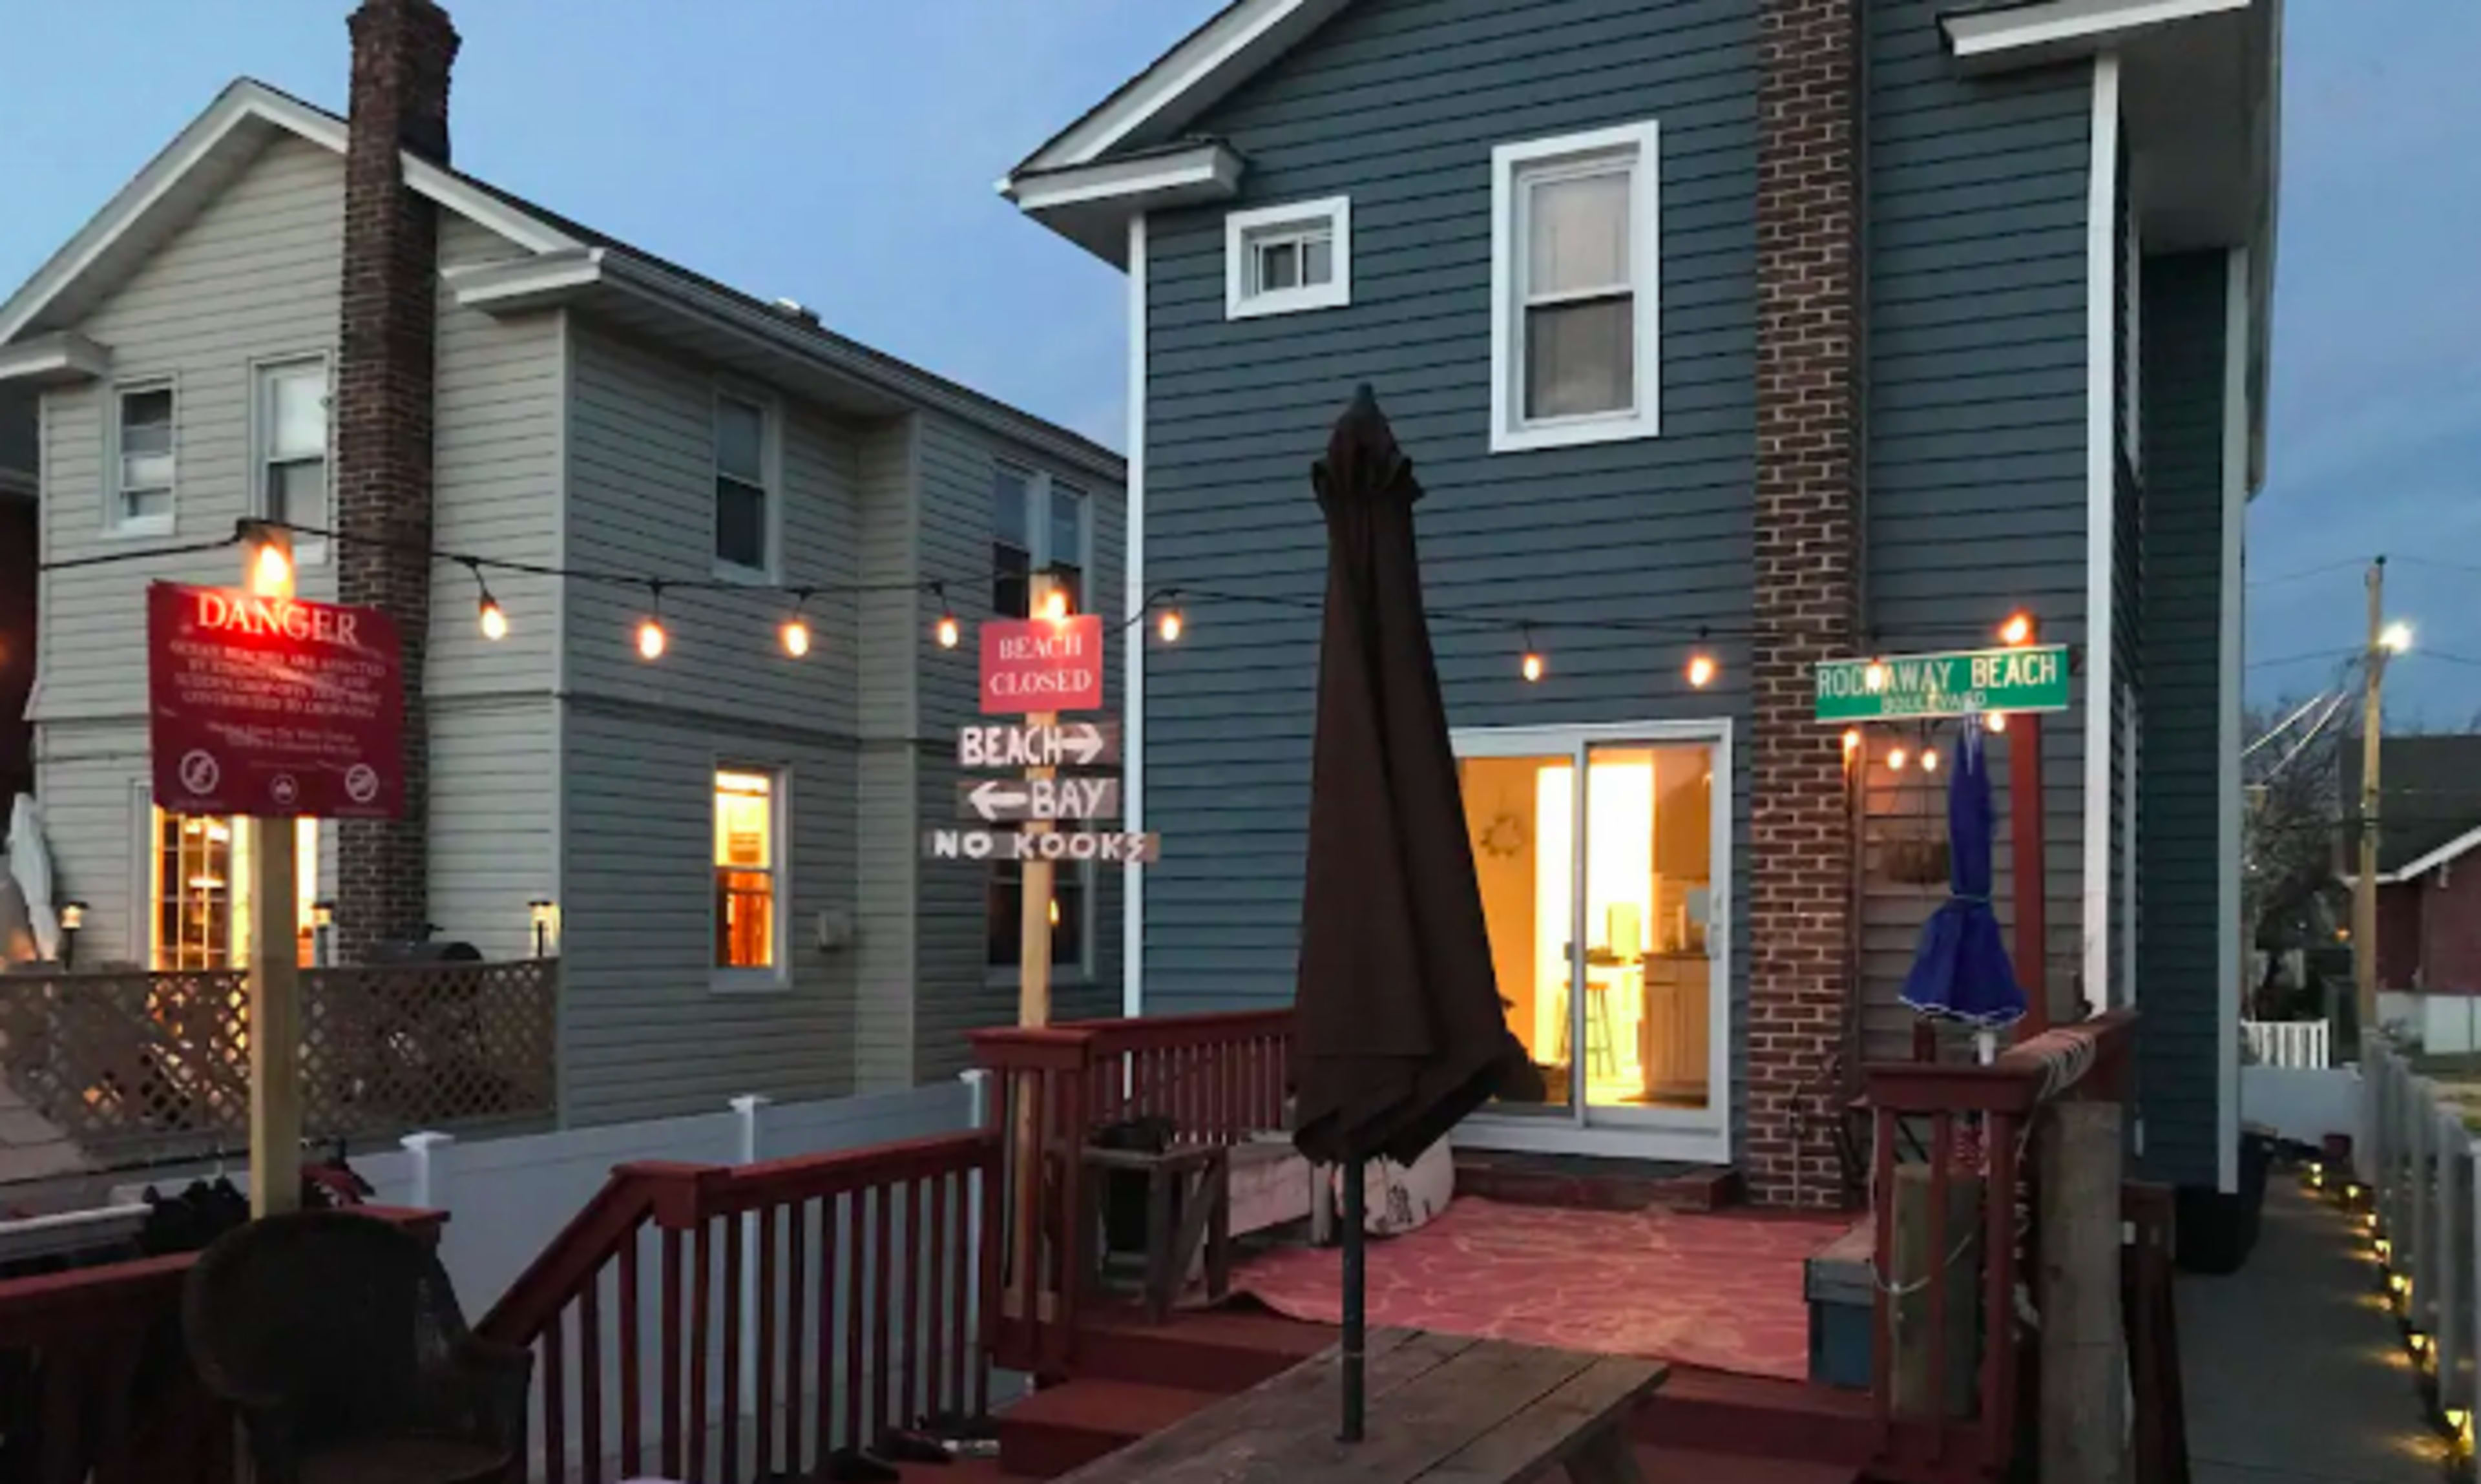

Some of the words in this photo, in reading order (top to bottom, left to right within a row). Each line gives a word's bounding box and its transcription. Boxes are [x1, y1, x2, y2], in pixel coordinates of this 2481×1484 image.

[198, 592, 359, 646] DANGER
[1000, 634, 1082, 660] BEACH
[989, 669, 1092, 696] CLOSED
[1971, 653, 2057, 688] BEACH
[1881, 691, 1988, 715] BOULEVAD
[961, 725, 1063, 766] BEACH
[1032, 778, 1106, 819] BAY
[934, 830, 993, 858] NO
[1014, 831, 1146, 860] KOOKS
